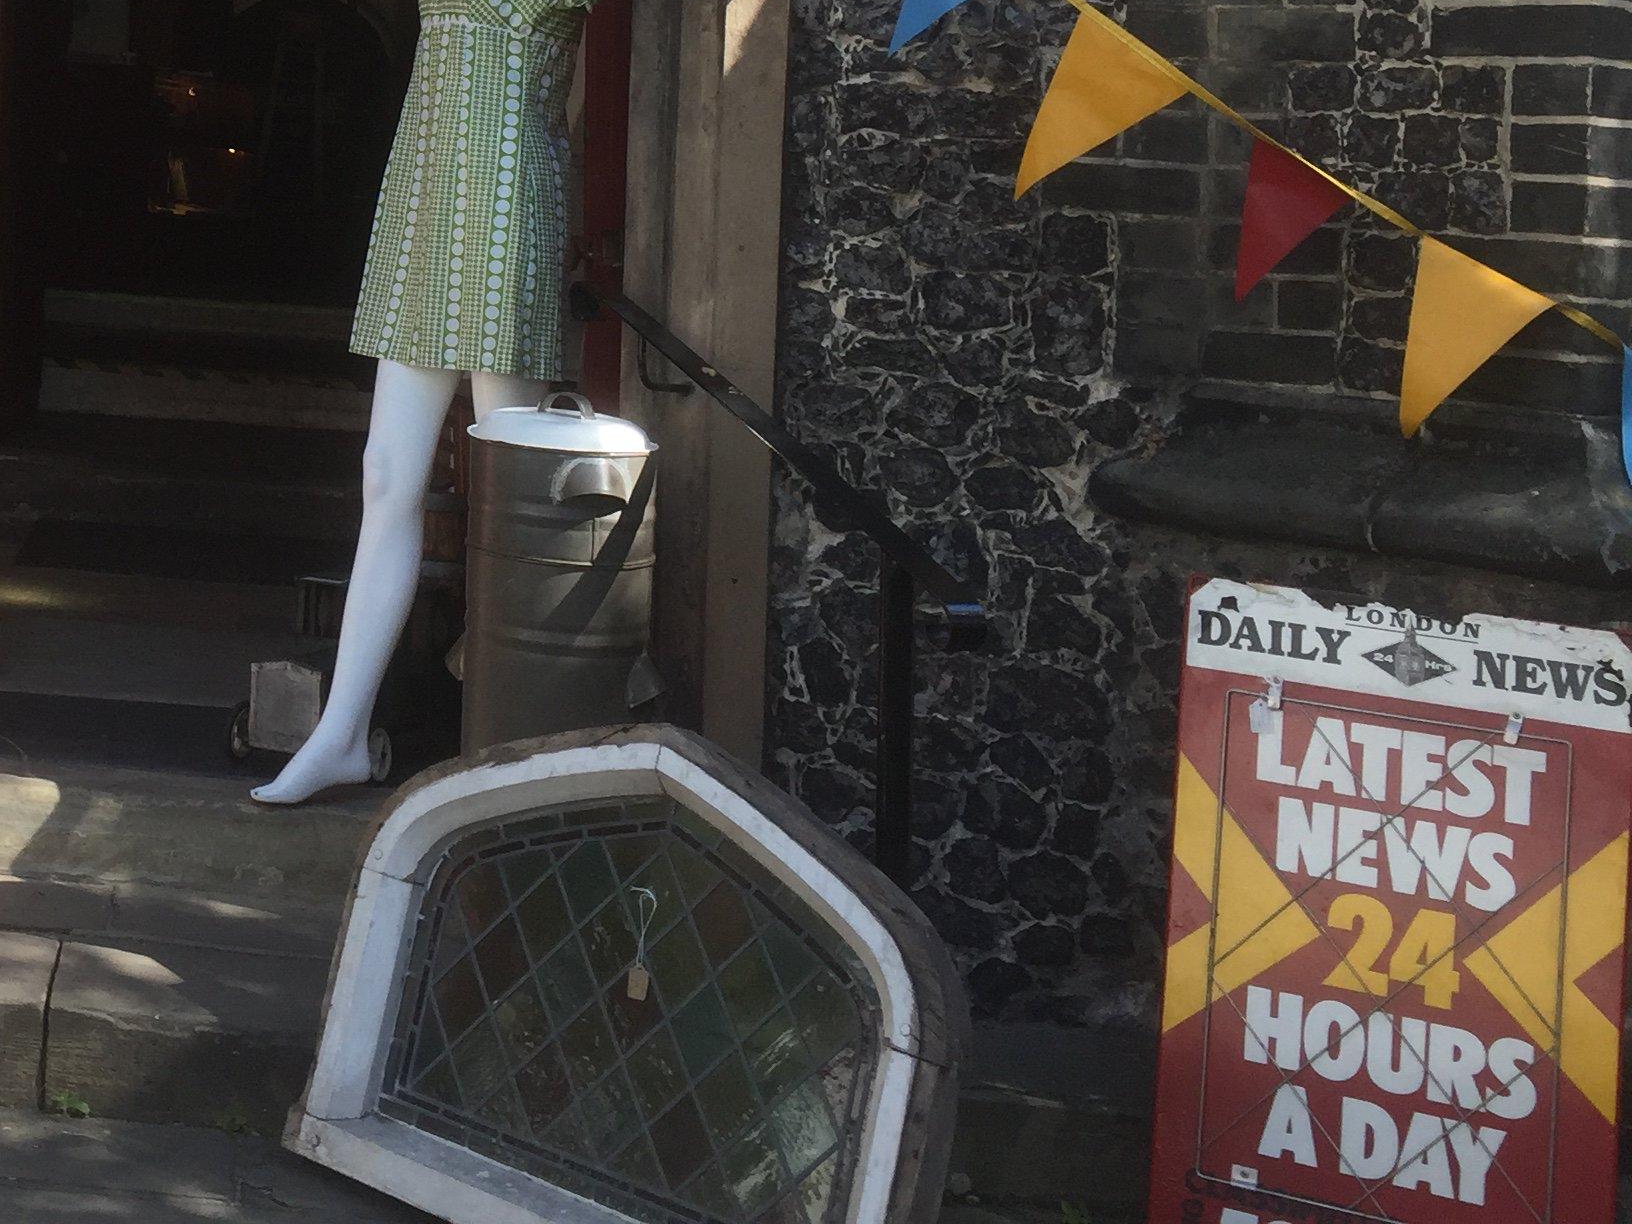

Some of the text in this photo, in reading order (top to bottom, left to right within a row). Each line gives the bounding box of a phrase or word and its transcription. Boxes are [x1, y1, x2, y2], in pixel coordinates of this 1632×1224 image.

[1197, 609, 1628, 707] DAILY NEWS
[1344, 605, 1482, 639] LONDON
[1372, 652, 1395, 664] 24
[1254, 705, 1548, 826] LATEST
[1275, 795, 1517, 913] NEWS
[1321, 892, 1462, 1011] 24
[1242, 983, 1538, 1122] HOURS
[1257, 1082, 1319, 1168] A
[1339, 1096, 1509, 1208] DAY
